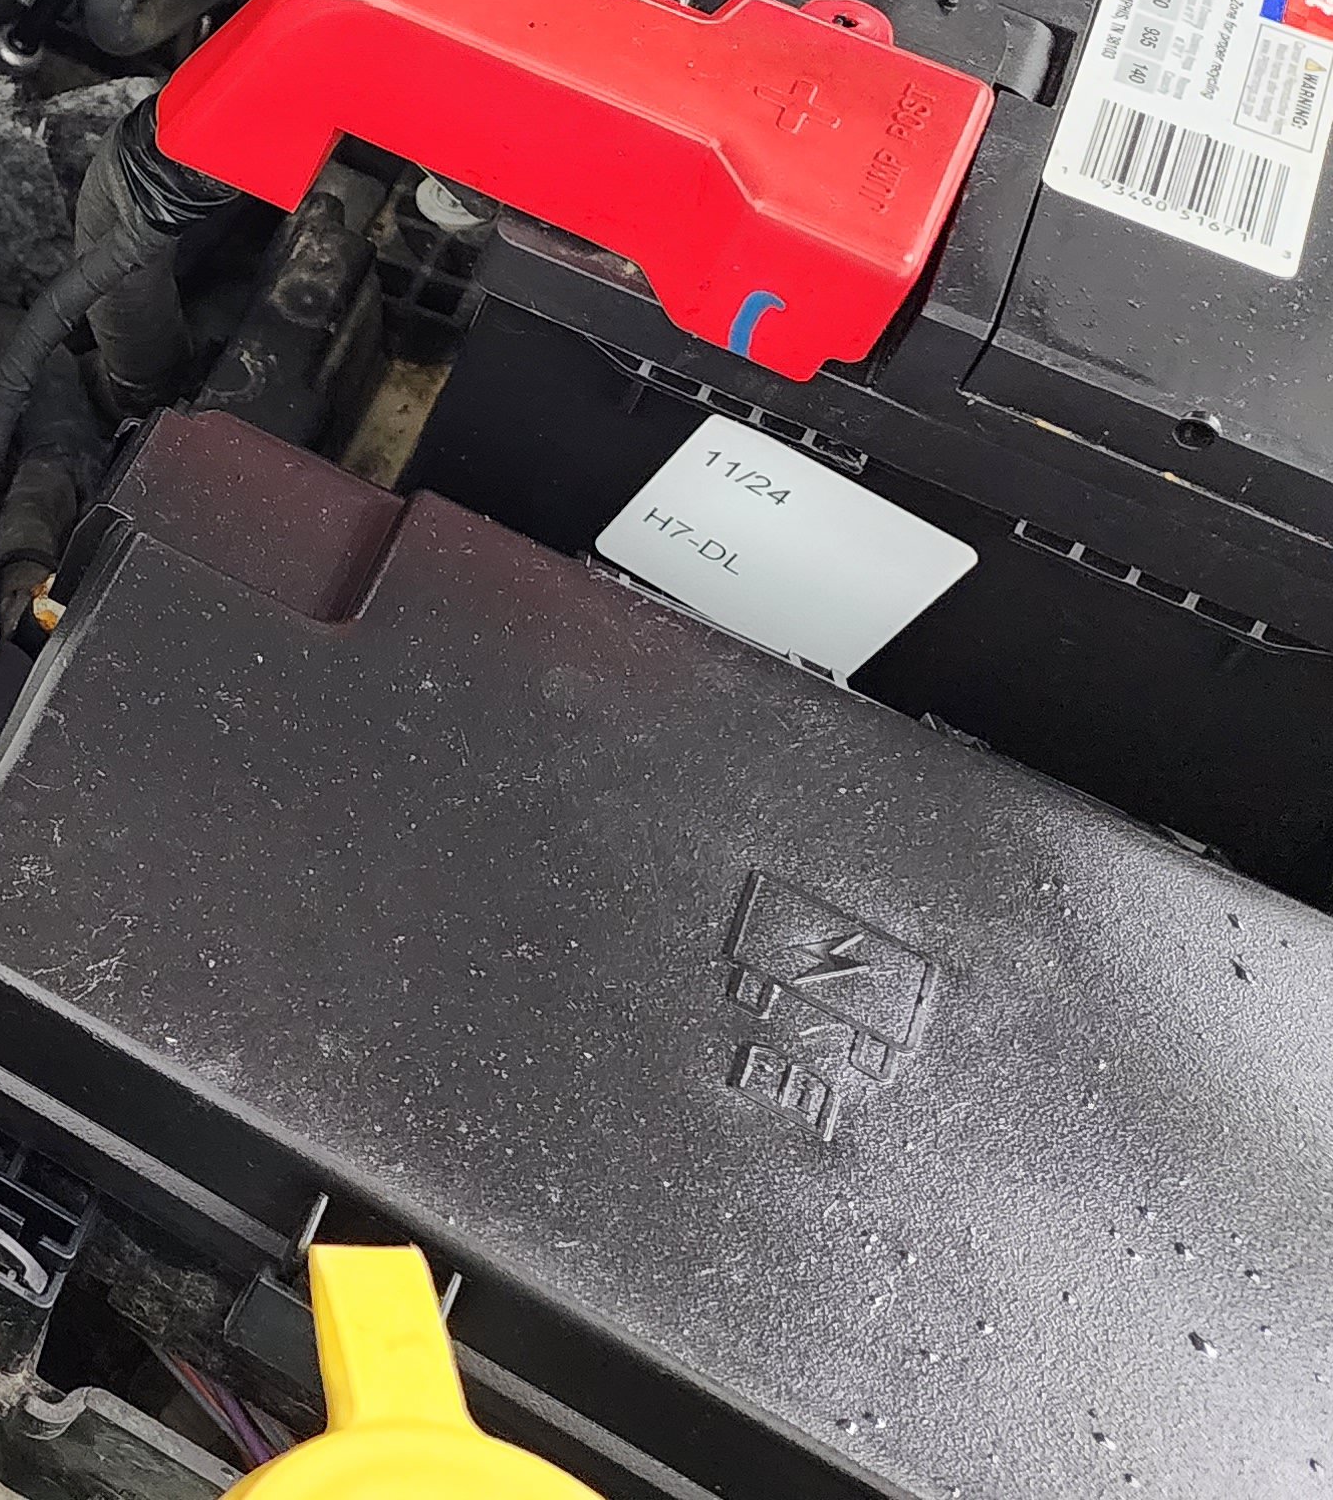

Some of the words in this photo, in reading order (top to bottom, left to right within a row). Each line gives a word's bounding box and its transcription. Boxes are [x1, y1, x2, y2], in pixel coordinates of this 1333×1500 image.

[1108, 21, 1125, 34] TN
[1138, 25, 1162, 49] 935
[1207, 30, 1230, 61] proper
[1127, 61, 1150, 85] 140
[1198, 59, 1225, 101] recycling
[1288, 71, 1321, 130] WARNING:
[858, 147, 905, 215] JUMP
[886, 83, 939, 141] POST
[702, 448, 794, 509] 11/24
[642, 505, 744, 578] H7-DL
